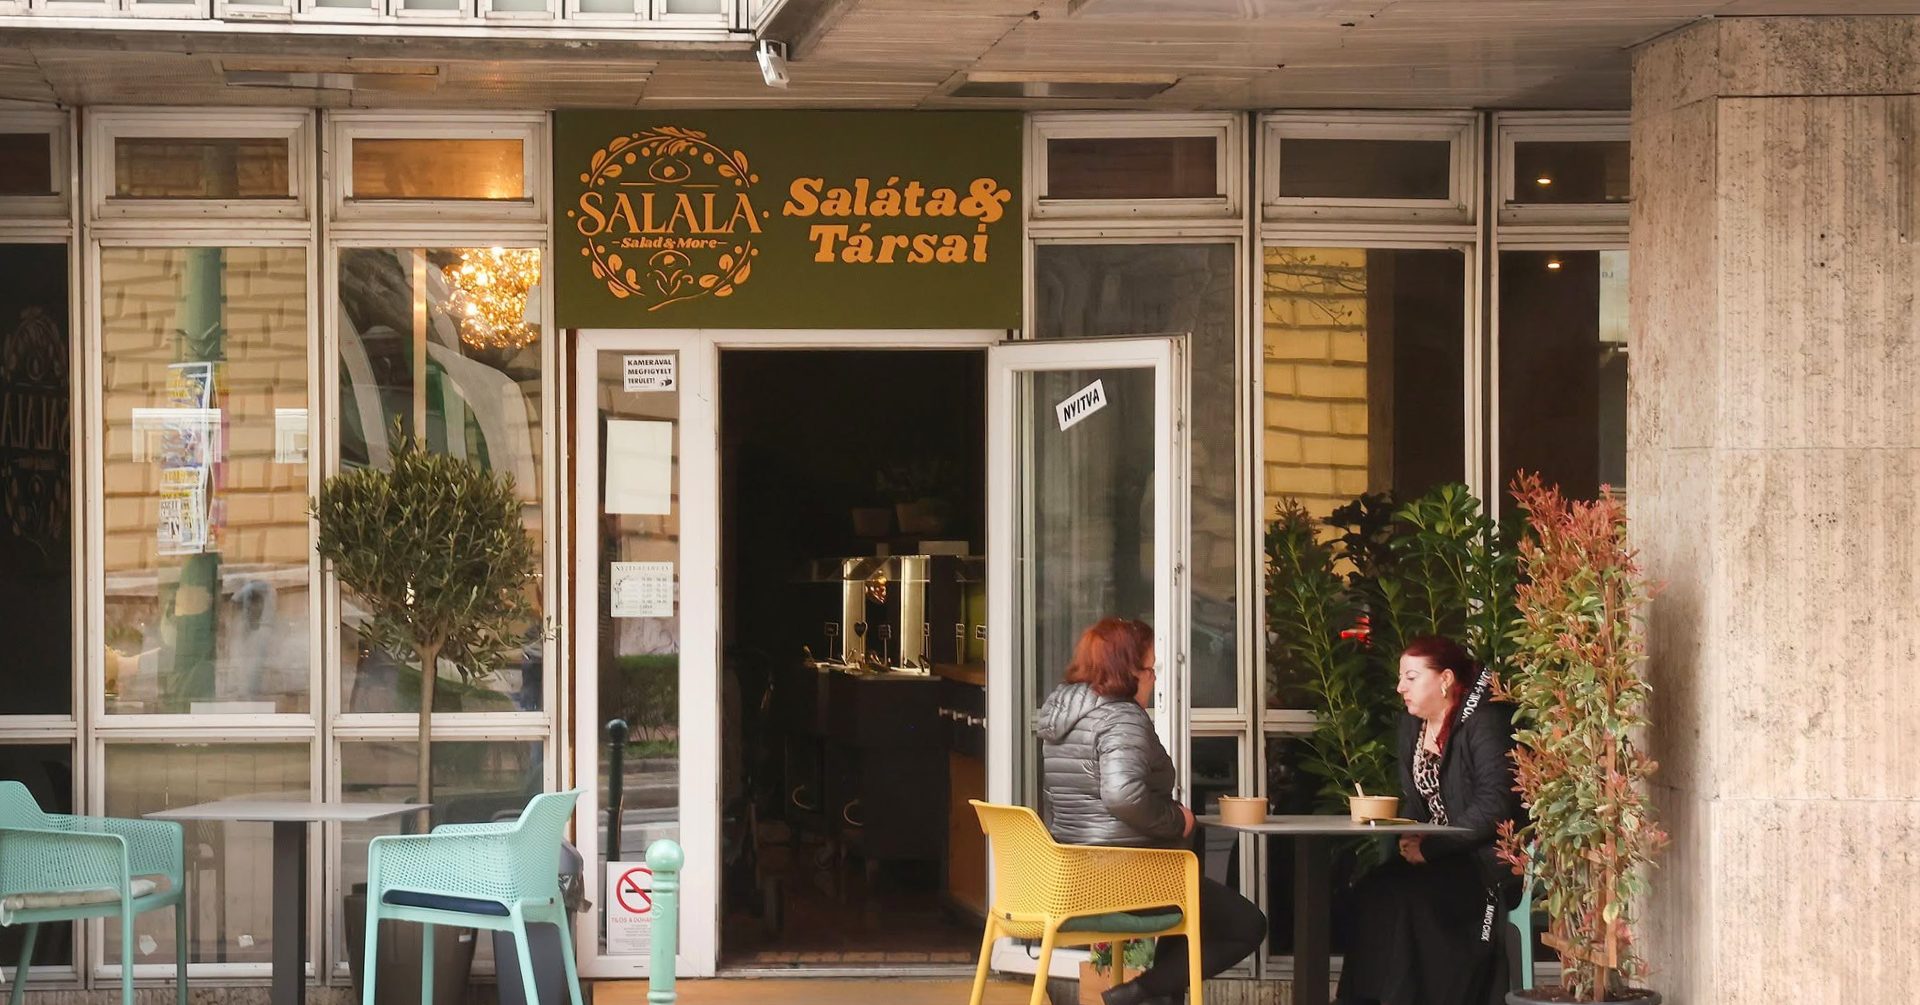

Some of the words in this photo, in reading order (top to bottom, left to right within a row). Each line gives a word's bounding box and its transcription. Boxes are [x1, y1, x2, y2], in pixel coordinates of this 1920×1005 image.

[576, 191, 763, 236] SALALA
[809, 222, 989, 264] Társai
[1063, 388, 1100, 422] NYITVA
[1483, 904, 1495, 925] MAYO
[1481, 924, 1491, 942] CHIX
